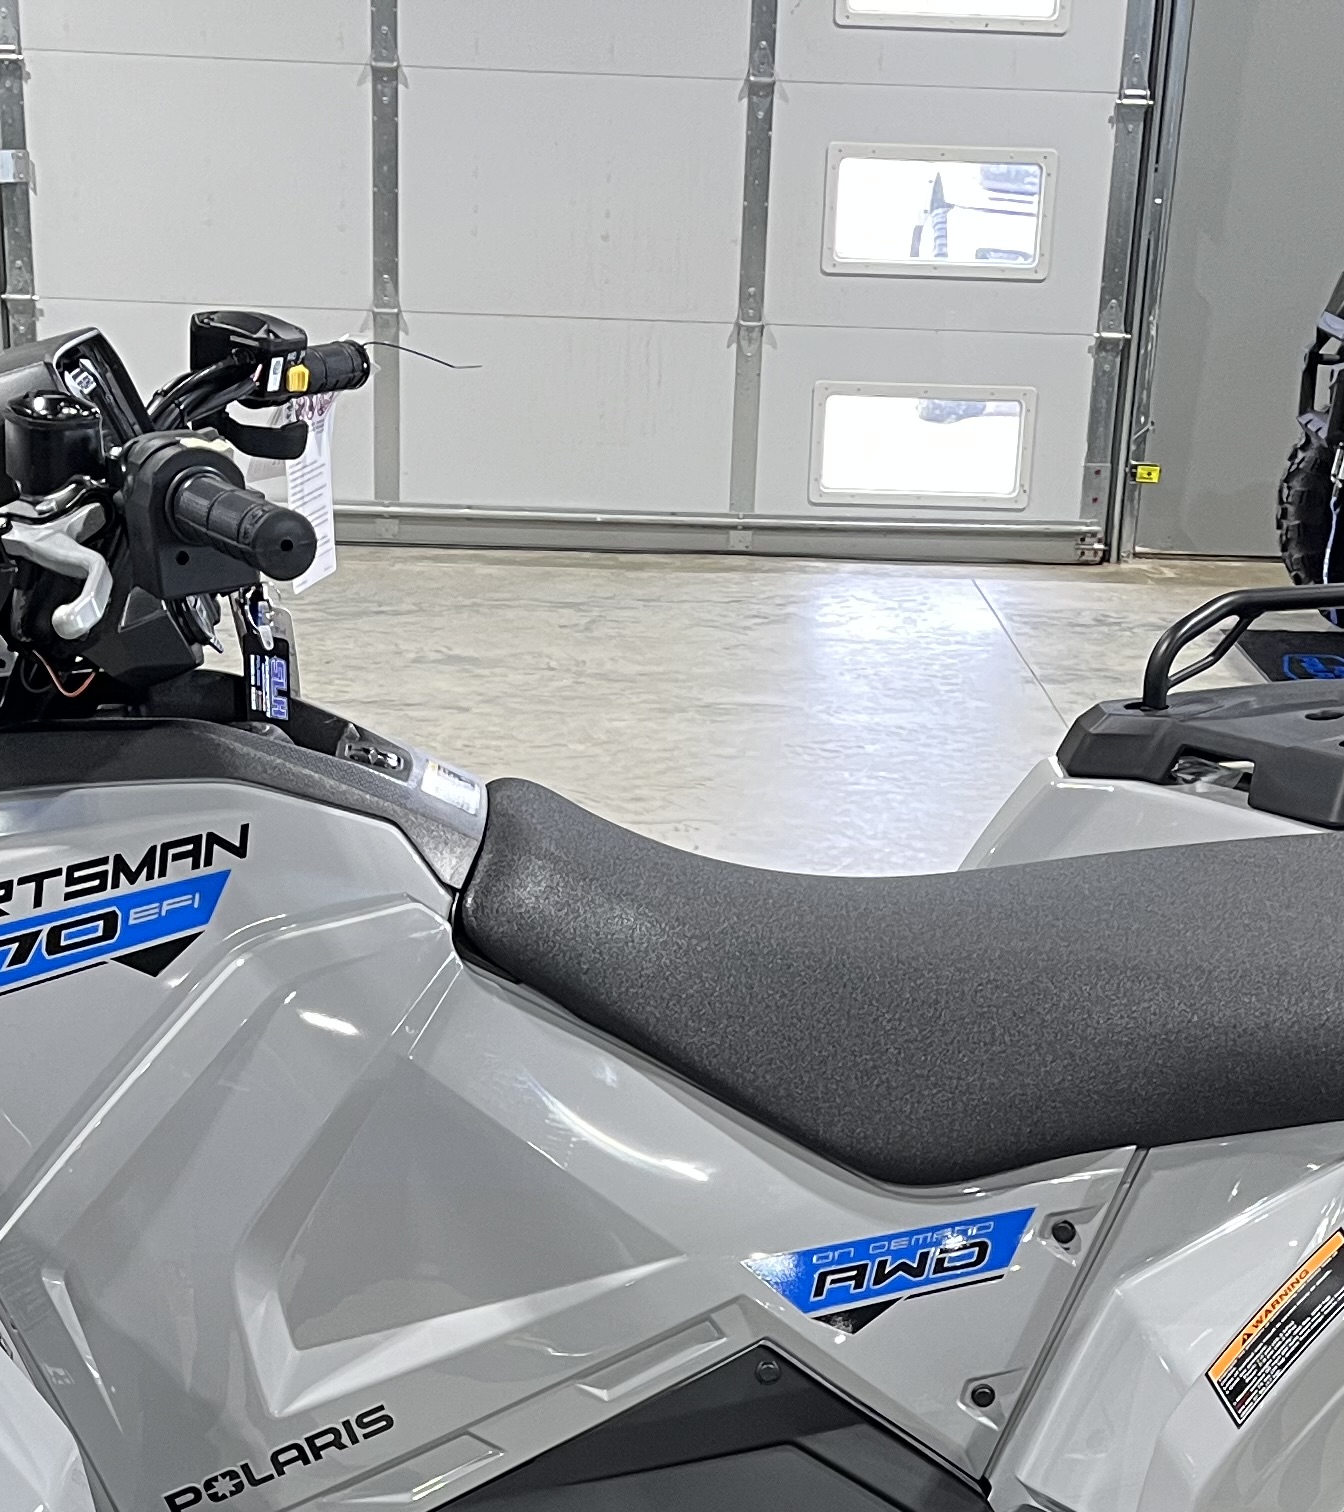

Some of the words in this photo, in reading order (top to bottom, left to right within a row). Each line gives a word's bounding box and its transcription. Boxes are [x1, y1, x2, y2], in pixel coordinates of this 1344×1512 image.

[129, 892, 201, 925] EFI
[809, 1239, 993, 1301] AWD
[1252, 1268, 1311, 1329] WARNING
